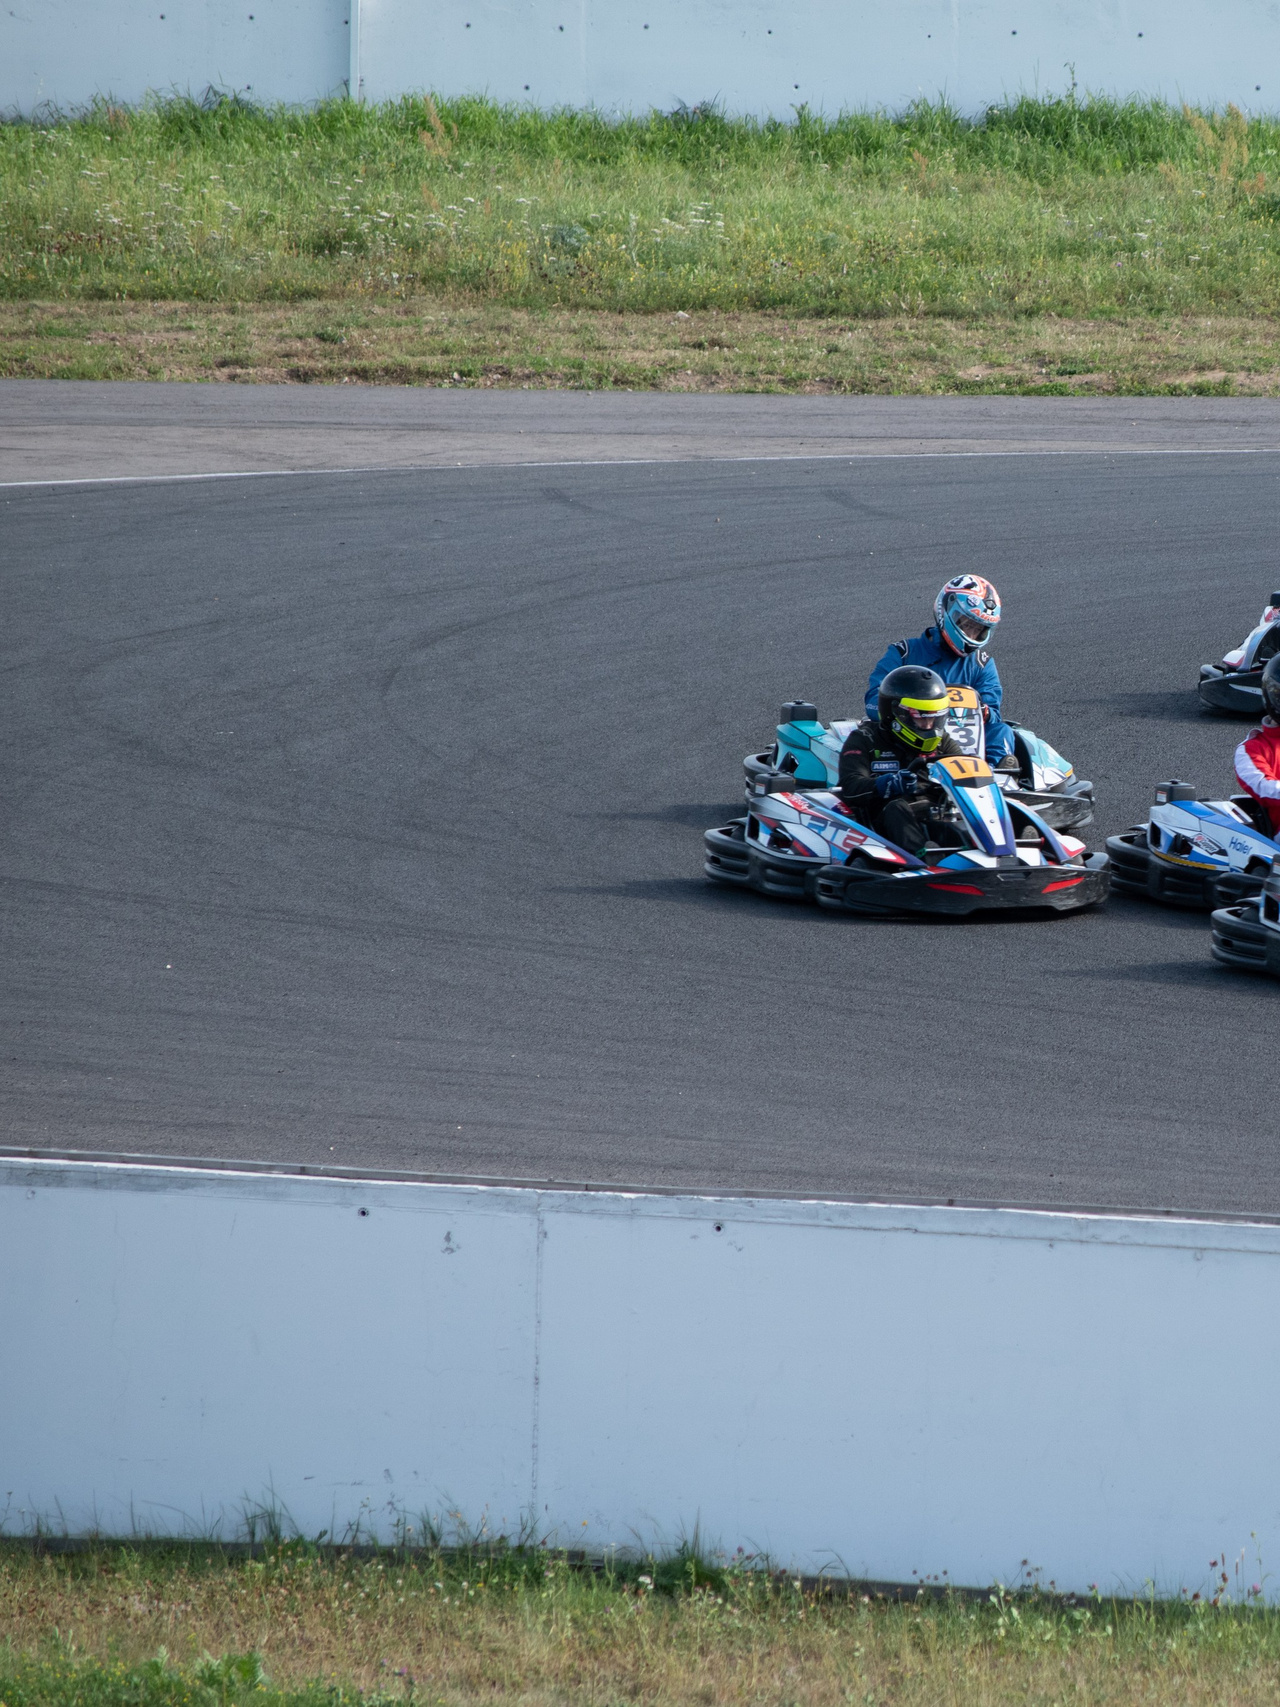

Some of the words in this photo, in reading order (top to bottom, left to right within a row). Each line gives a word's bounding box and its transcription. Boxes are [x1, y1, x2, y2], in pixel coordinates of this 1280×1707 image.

[946, 688, 965, 702] 3
[952, 727, 976, 747] 3
[949, 758, 979, 774] 17
[1229, 836, 1253, 855] Haier
